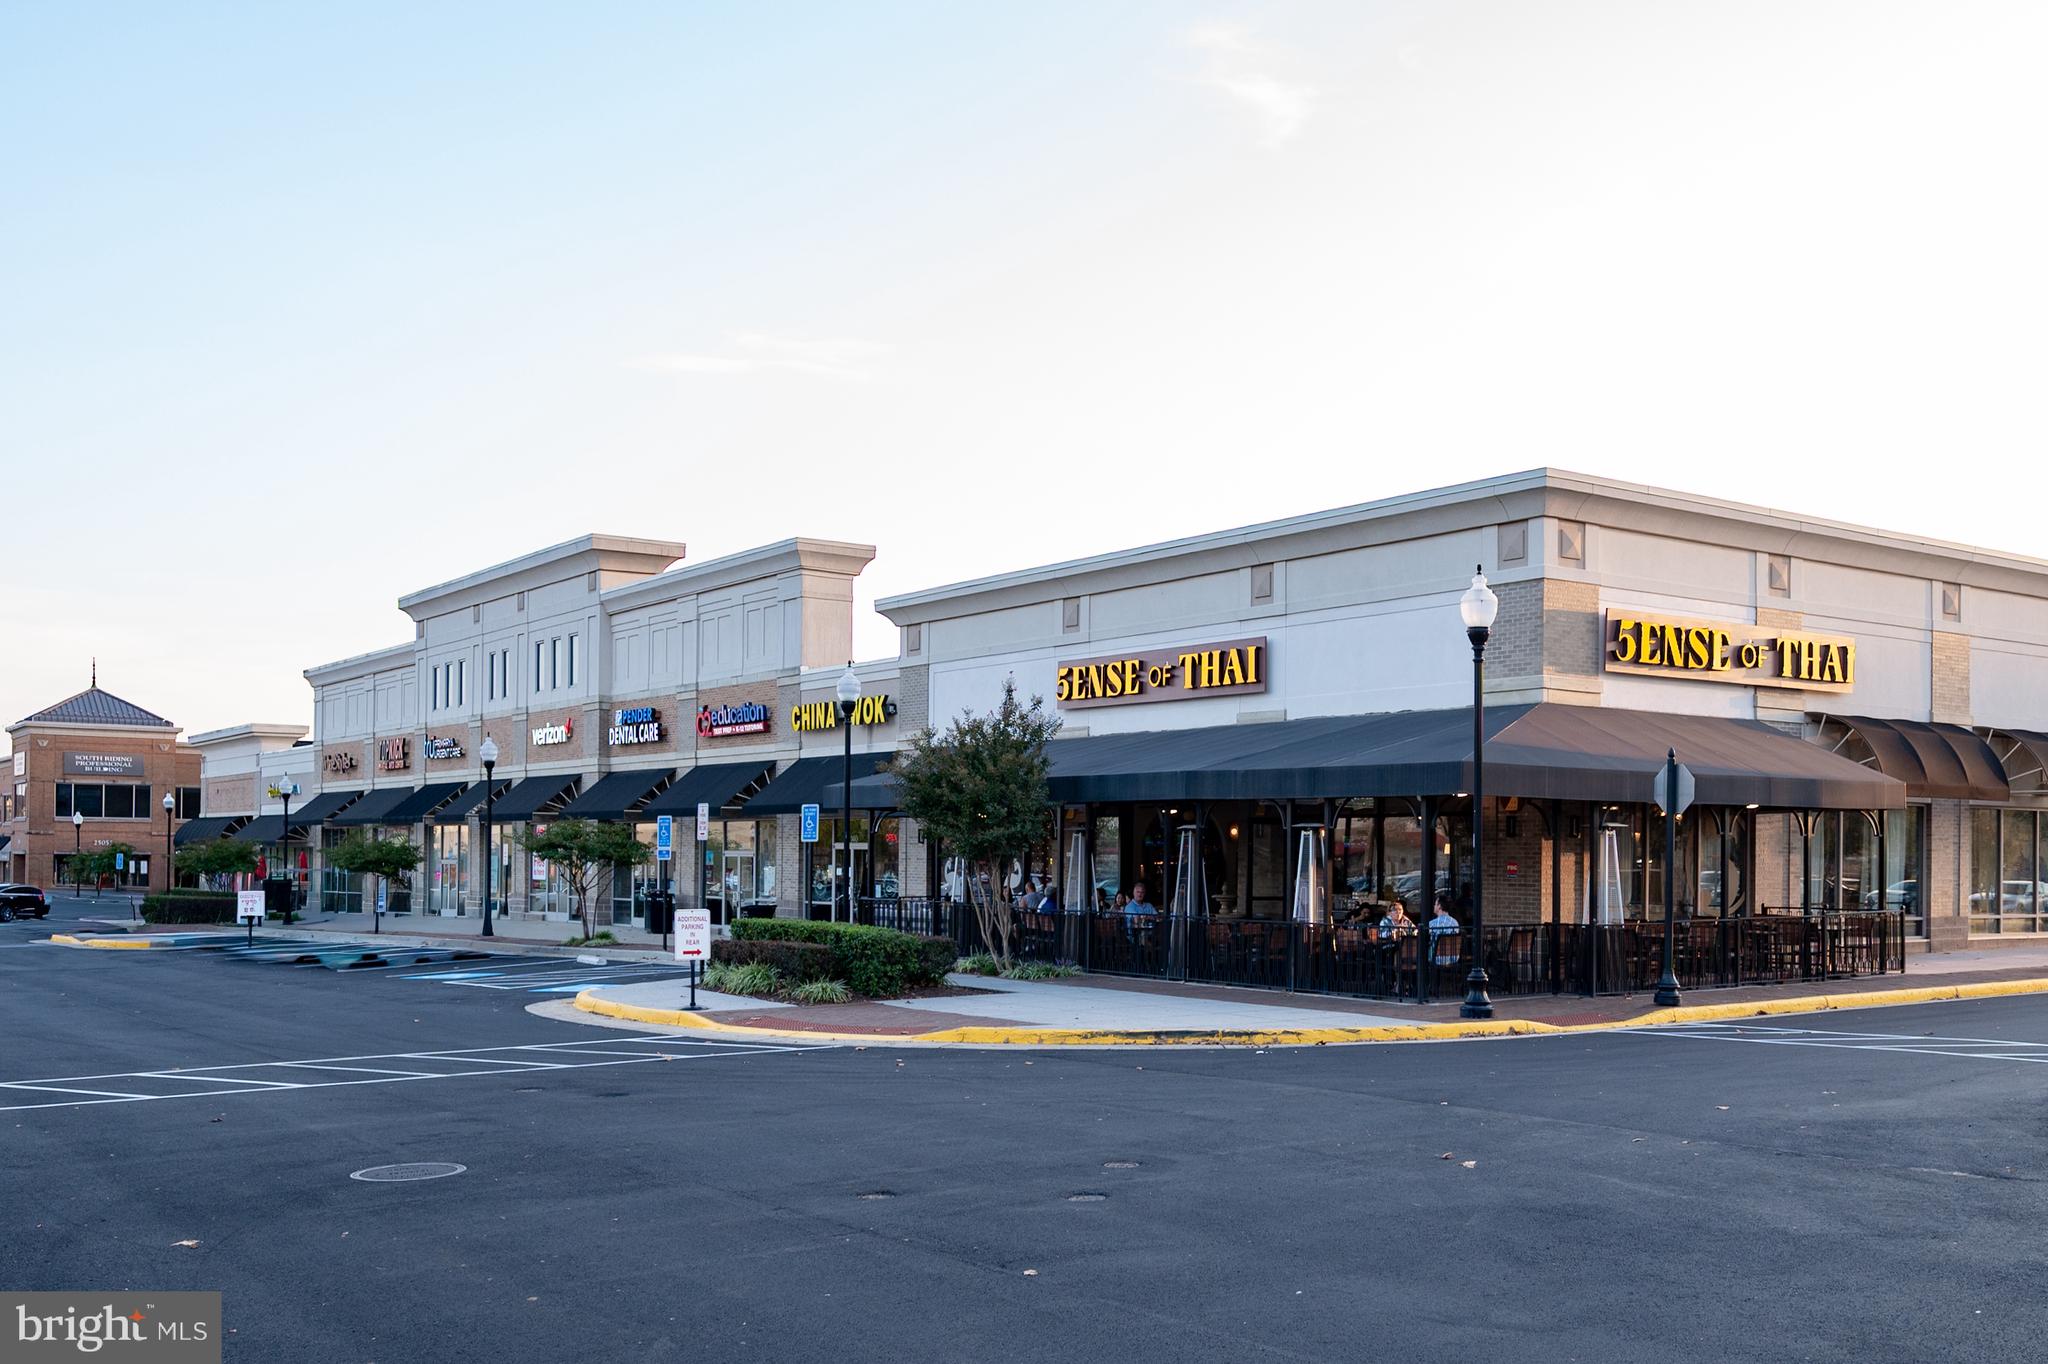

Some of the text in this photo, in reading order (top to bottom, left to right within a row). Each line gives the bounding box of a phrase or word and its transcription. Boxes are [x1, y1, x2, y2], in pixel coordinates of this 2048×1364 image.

[1149, 664, 1173, 688] OF
[1178, 646, 1257, 689] THAI
[1741, 642, 1769, 668] OF
[1776, 637, 1856, 683] THAI
[623, 707, 653, 724] PENDER
[711, 702, 764, 726] education
[790, 701, 835, 732] CHINA
[532, 722, 567, 745] verizon
[608, 722, 659, 746] DENTAL CARE
[75, 760, 133, 768] PROFESSIONAL
